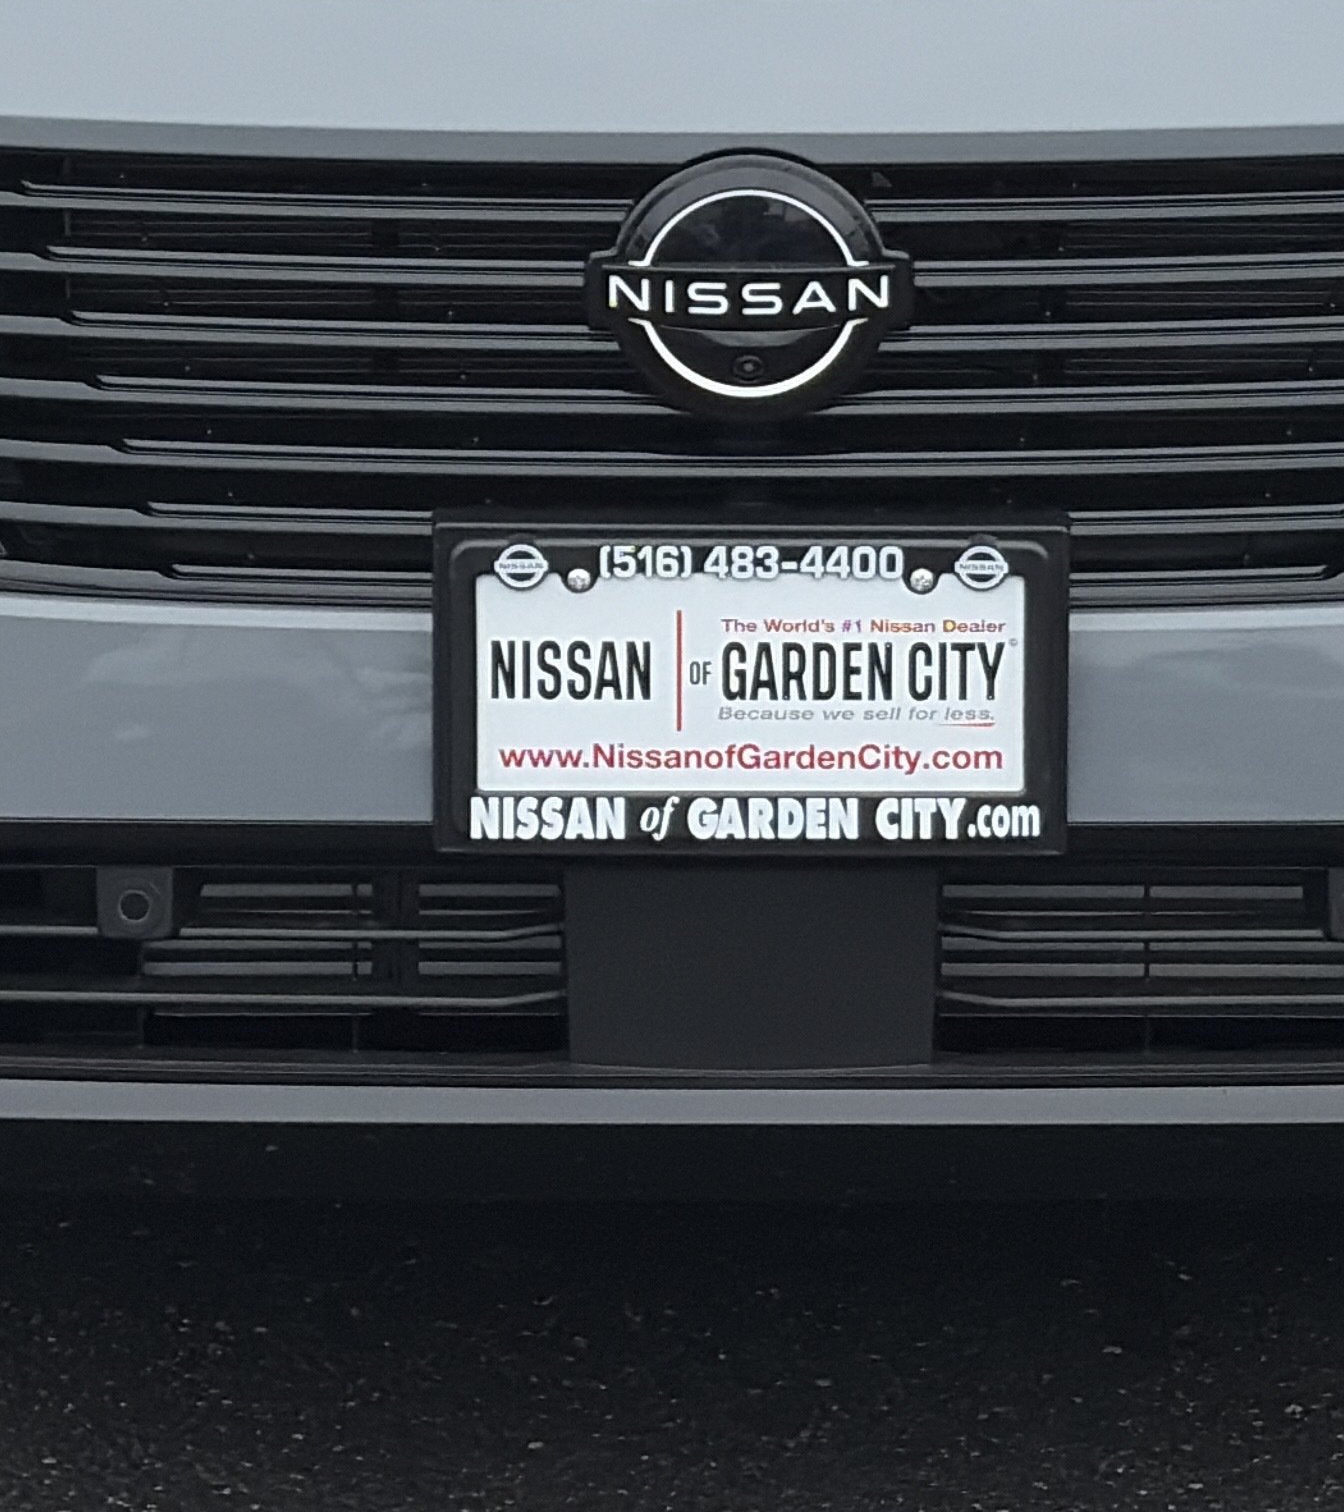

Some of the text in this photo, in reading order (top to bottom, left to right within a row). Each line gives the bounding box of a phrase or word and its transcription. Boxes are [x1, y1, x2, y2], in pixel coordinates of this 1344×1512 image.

[608, 274, 889, 315] NISSAN
[599, 545, 904, 579] (516) 483-4400
[721, 618, 1006, 634] The World's #1 Nissan Dealer
[491, 640, 1005, 701] NISSAN OF GARDEN CITY
[718, 706, 994, 721] Because we sell for less.
[499, 744, 1003, 775] www.NissanofGardenCity.com
[470, 796, 626, 840] NISSAN
[640, 795, 679, 841] of
[687, 797, 859, 840] GARDEN
